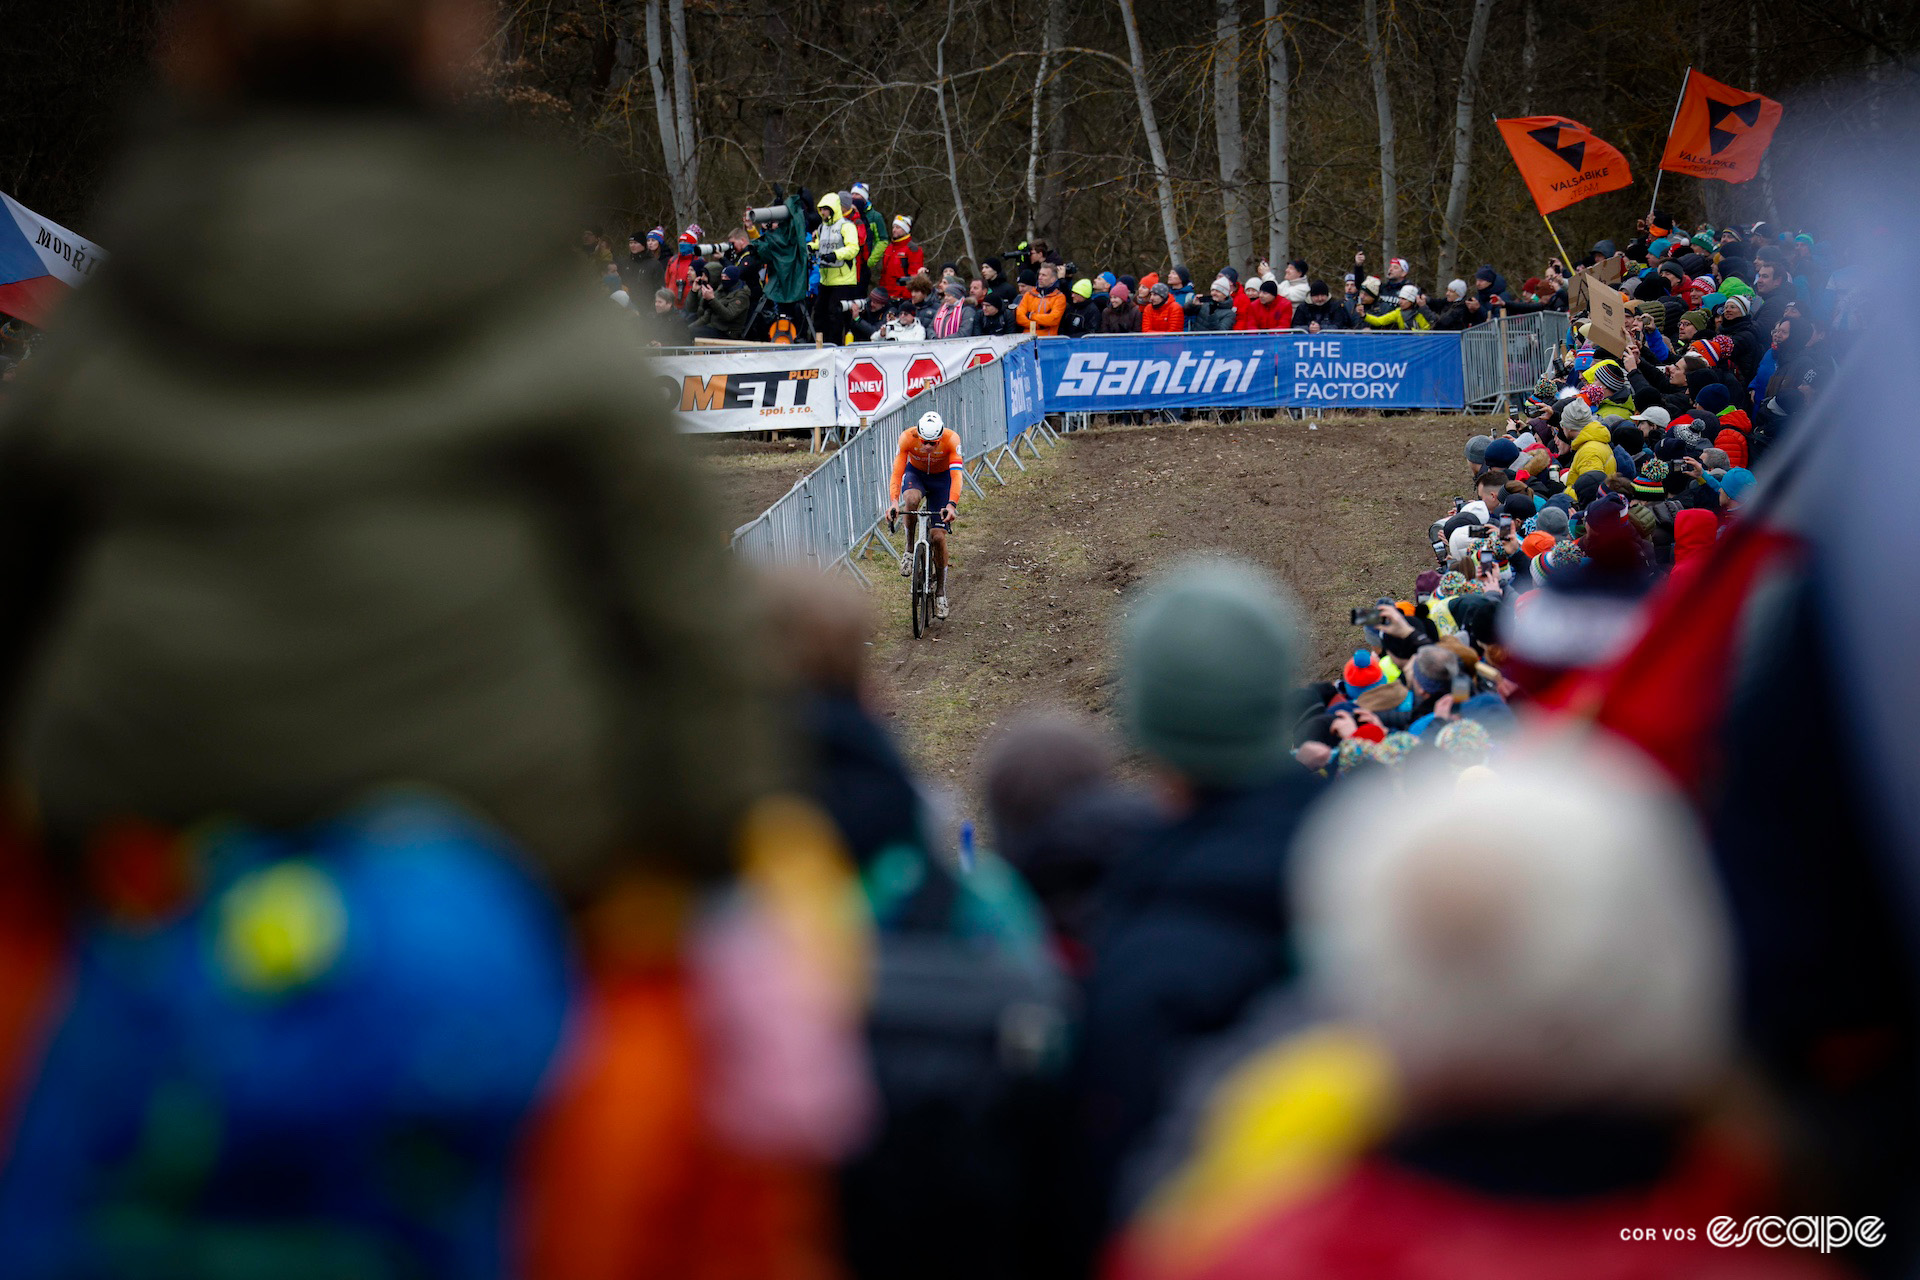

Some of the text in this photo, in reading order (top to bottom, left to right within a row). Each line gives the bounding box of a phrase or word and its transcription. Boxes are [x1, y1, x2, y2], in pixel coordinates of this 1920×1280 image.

[1679, 150, 1737, 170] VALSABIKE
[1550, 167, 1609, 192] VALSABIKE
[1294, 341, 1341, 358] THE
[788, 369, 820, 380] PLUS
[1056, 349, 1264, 396] Santini
[1294, 362, 1408, 379] RAINBOW
[849, 380, 883, 394] JANEV
[1294, 382, 1400, 400] FACTORY
[759, 407, 786, 417] spol.
[797, 405, 814, 414] r.o.
